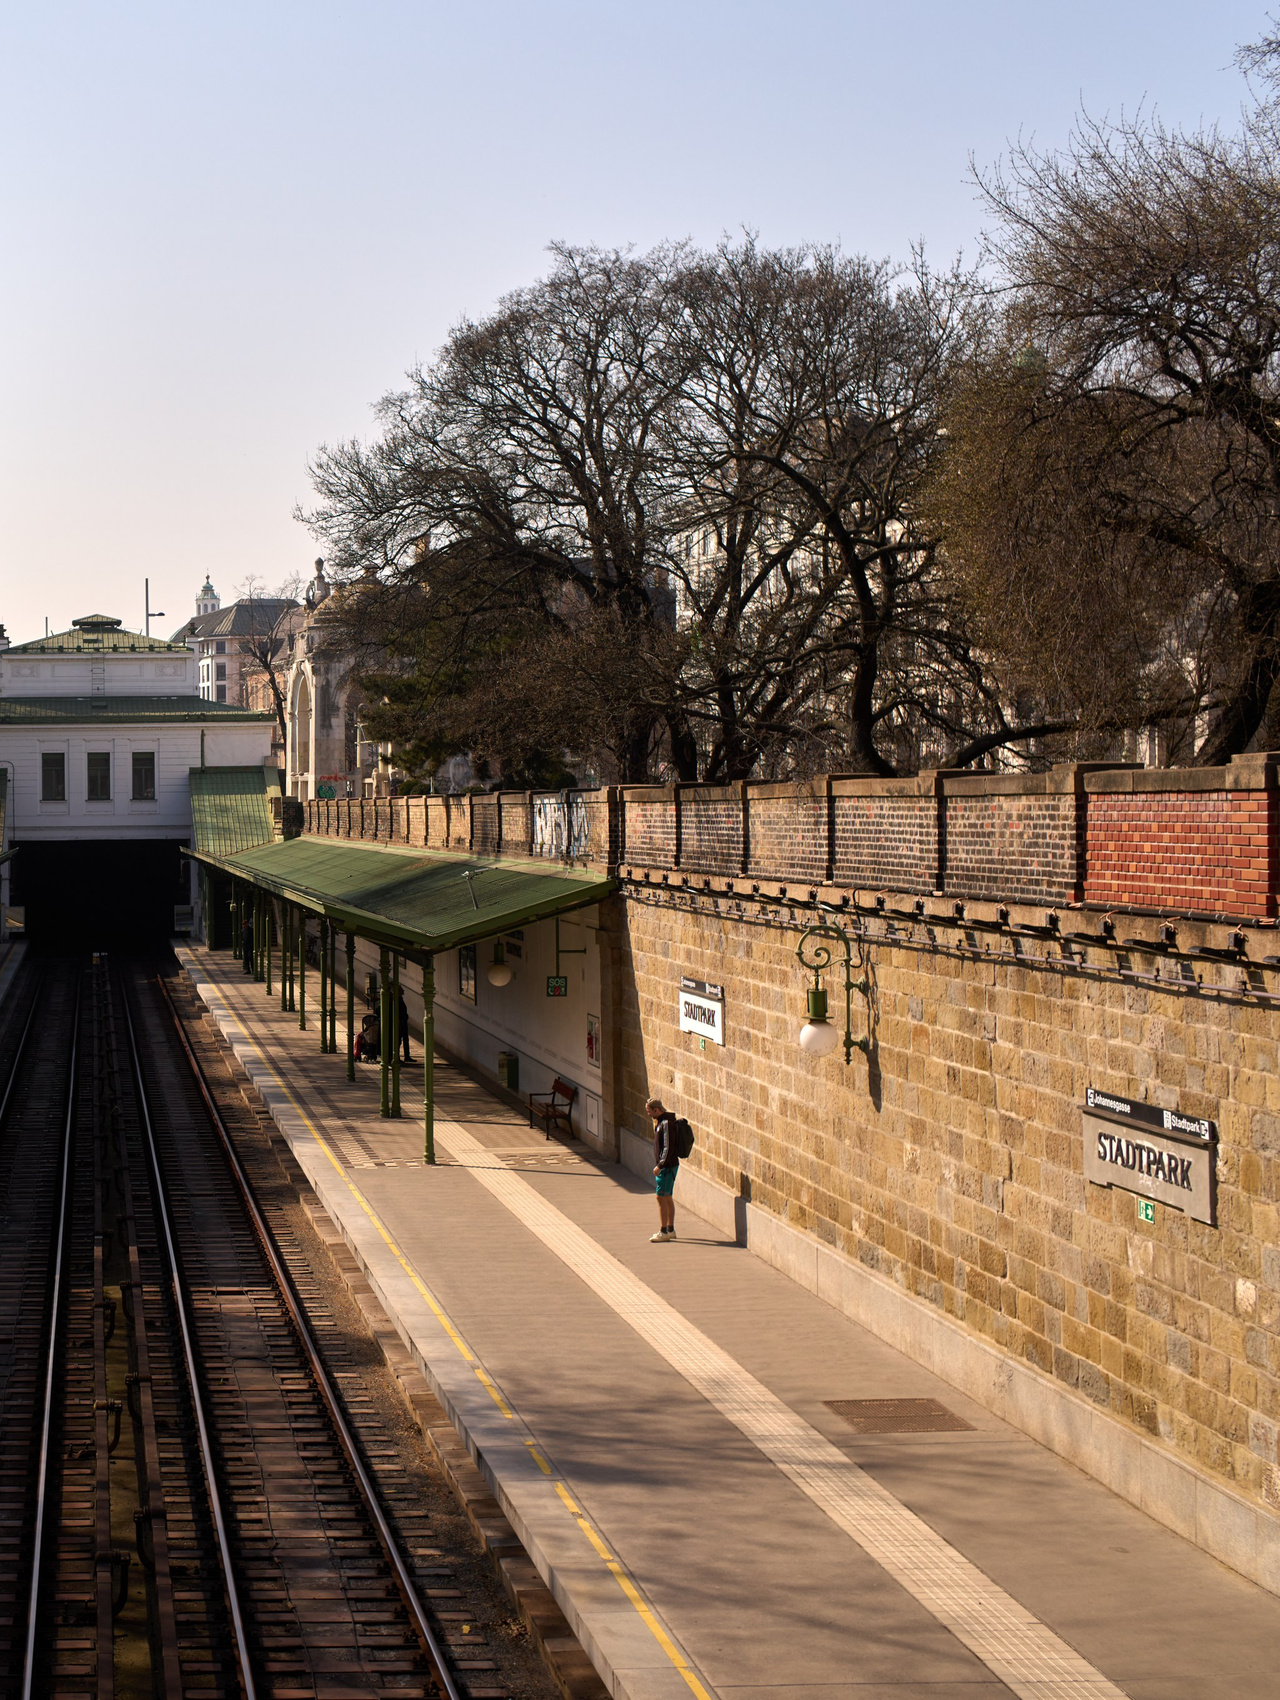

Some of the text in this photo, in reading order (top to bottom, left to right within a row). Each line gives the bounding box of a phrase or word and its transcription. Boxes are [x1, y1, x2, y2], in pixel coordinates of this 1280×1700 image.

[548, 978, 566, 987] SOS
[683, 1000, 716, 1028] STADTPARK
[1094, 1093, 1131, 1114] Johannesgasse
[1171, 1114, 1201, 1133] Stadtpark
[1097, 1131, 1193, 1192] STADTPARK
